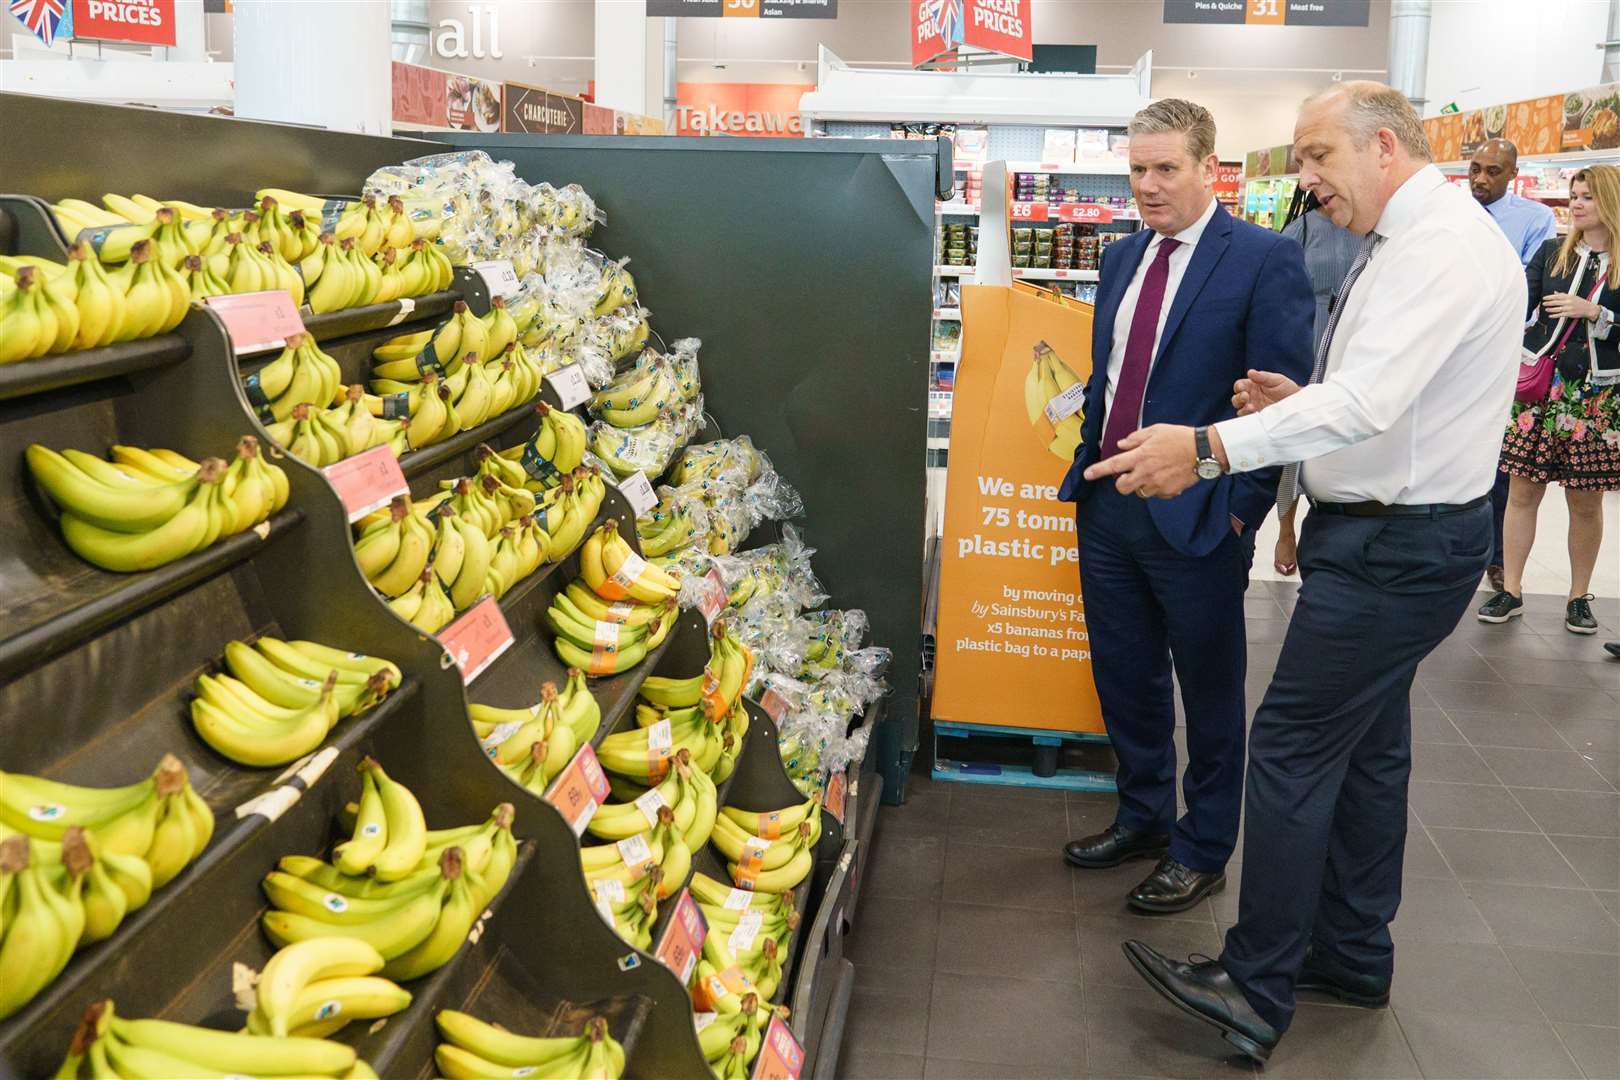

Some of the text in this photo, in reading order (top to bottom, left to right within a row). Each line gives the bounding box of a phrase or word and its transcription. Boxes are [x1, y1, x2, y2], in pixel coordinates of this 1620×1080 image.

[87, 0, 162, 26] PRICES
[763, 8, 783, 16] Asian
[1218, 2, 1243, 11] Quiche
[1252, 0, 1278, 16] 31
[1290, 3, 1324, 11] Meat free
[429, 5, 503, 59] all
[973, 6, 1024, 38] PRICES
[523, 103, 568, 127] CHARCUTERIE
[676, 103, 804, 134] Takeawa
[1013, 205, 1031, 217] £6
[1072, 207, 1100, 217] £2.80
[977, 476, 1058, 501] We are
[982, 506, 1077, 533] 75 tonn
[958, 534, 1079, 566] plastic pe
[1003, 585, 1021, 601] by
[1023, 588, 1075, 604] moving
[971, 600, 1086, 623] by Sainsbury's Fa
[987, 622, 1002, 634] x5
[1005, 622, 1063, 639] bananas
[956, 637, 1002, 653] plastic
[1004, 640, 1030, 657] bag
[1033, 643, 1048, 657] to
[1050, 647, 1058, 657] a
